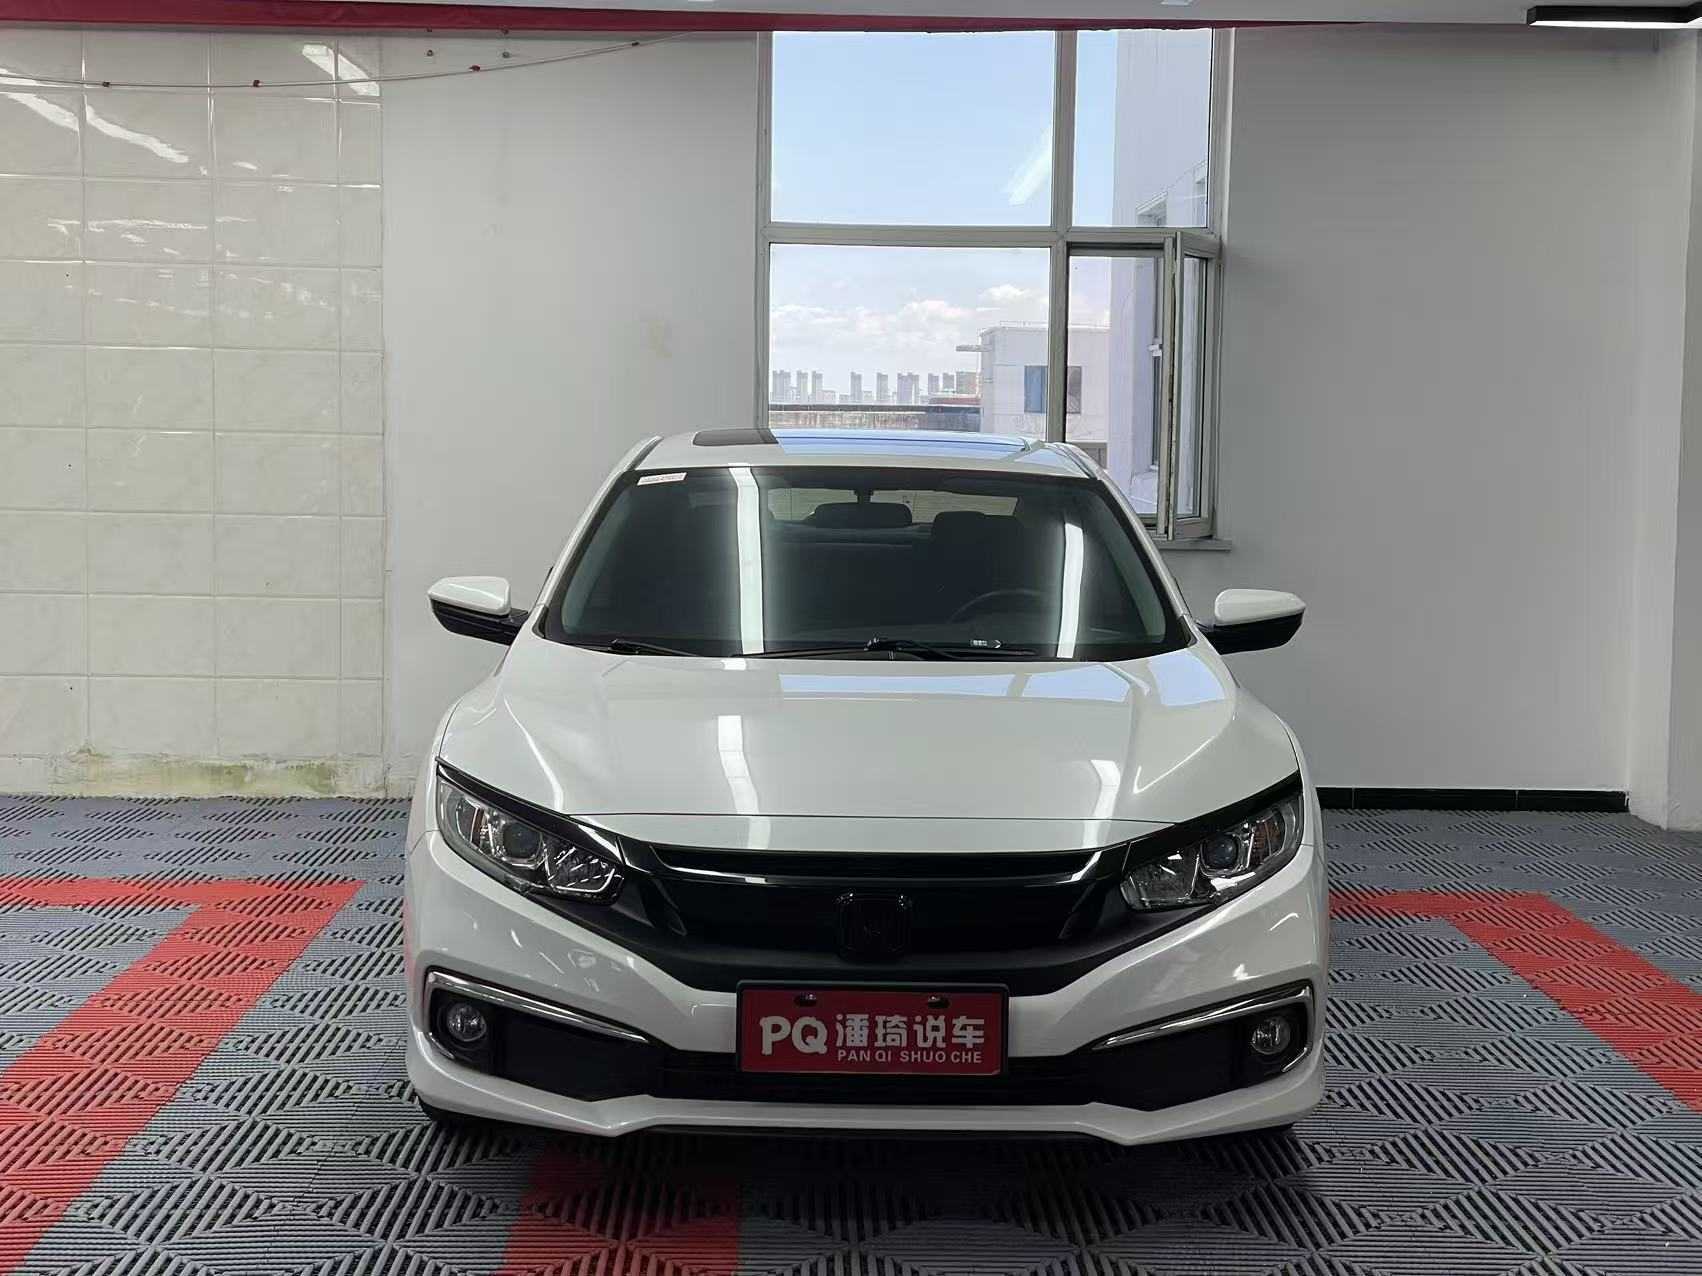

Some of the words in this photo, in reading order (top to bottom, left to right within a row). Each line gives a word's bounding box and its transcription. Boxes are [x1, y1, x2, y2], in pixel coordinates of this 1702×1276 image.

[759, 1015, 828, 1056] PQ
[835, 1013, 985, 1049] 潘琦说车
[837, 1050, 871, 1062] PAN
[874, 1050, 892, 1062] QI
[899, 1050, 947, 1064] SHUO
[950, 1051, 983, 1064] CHE
